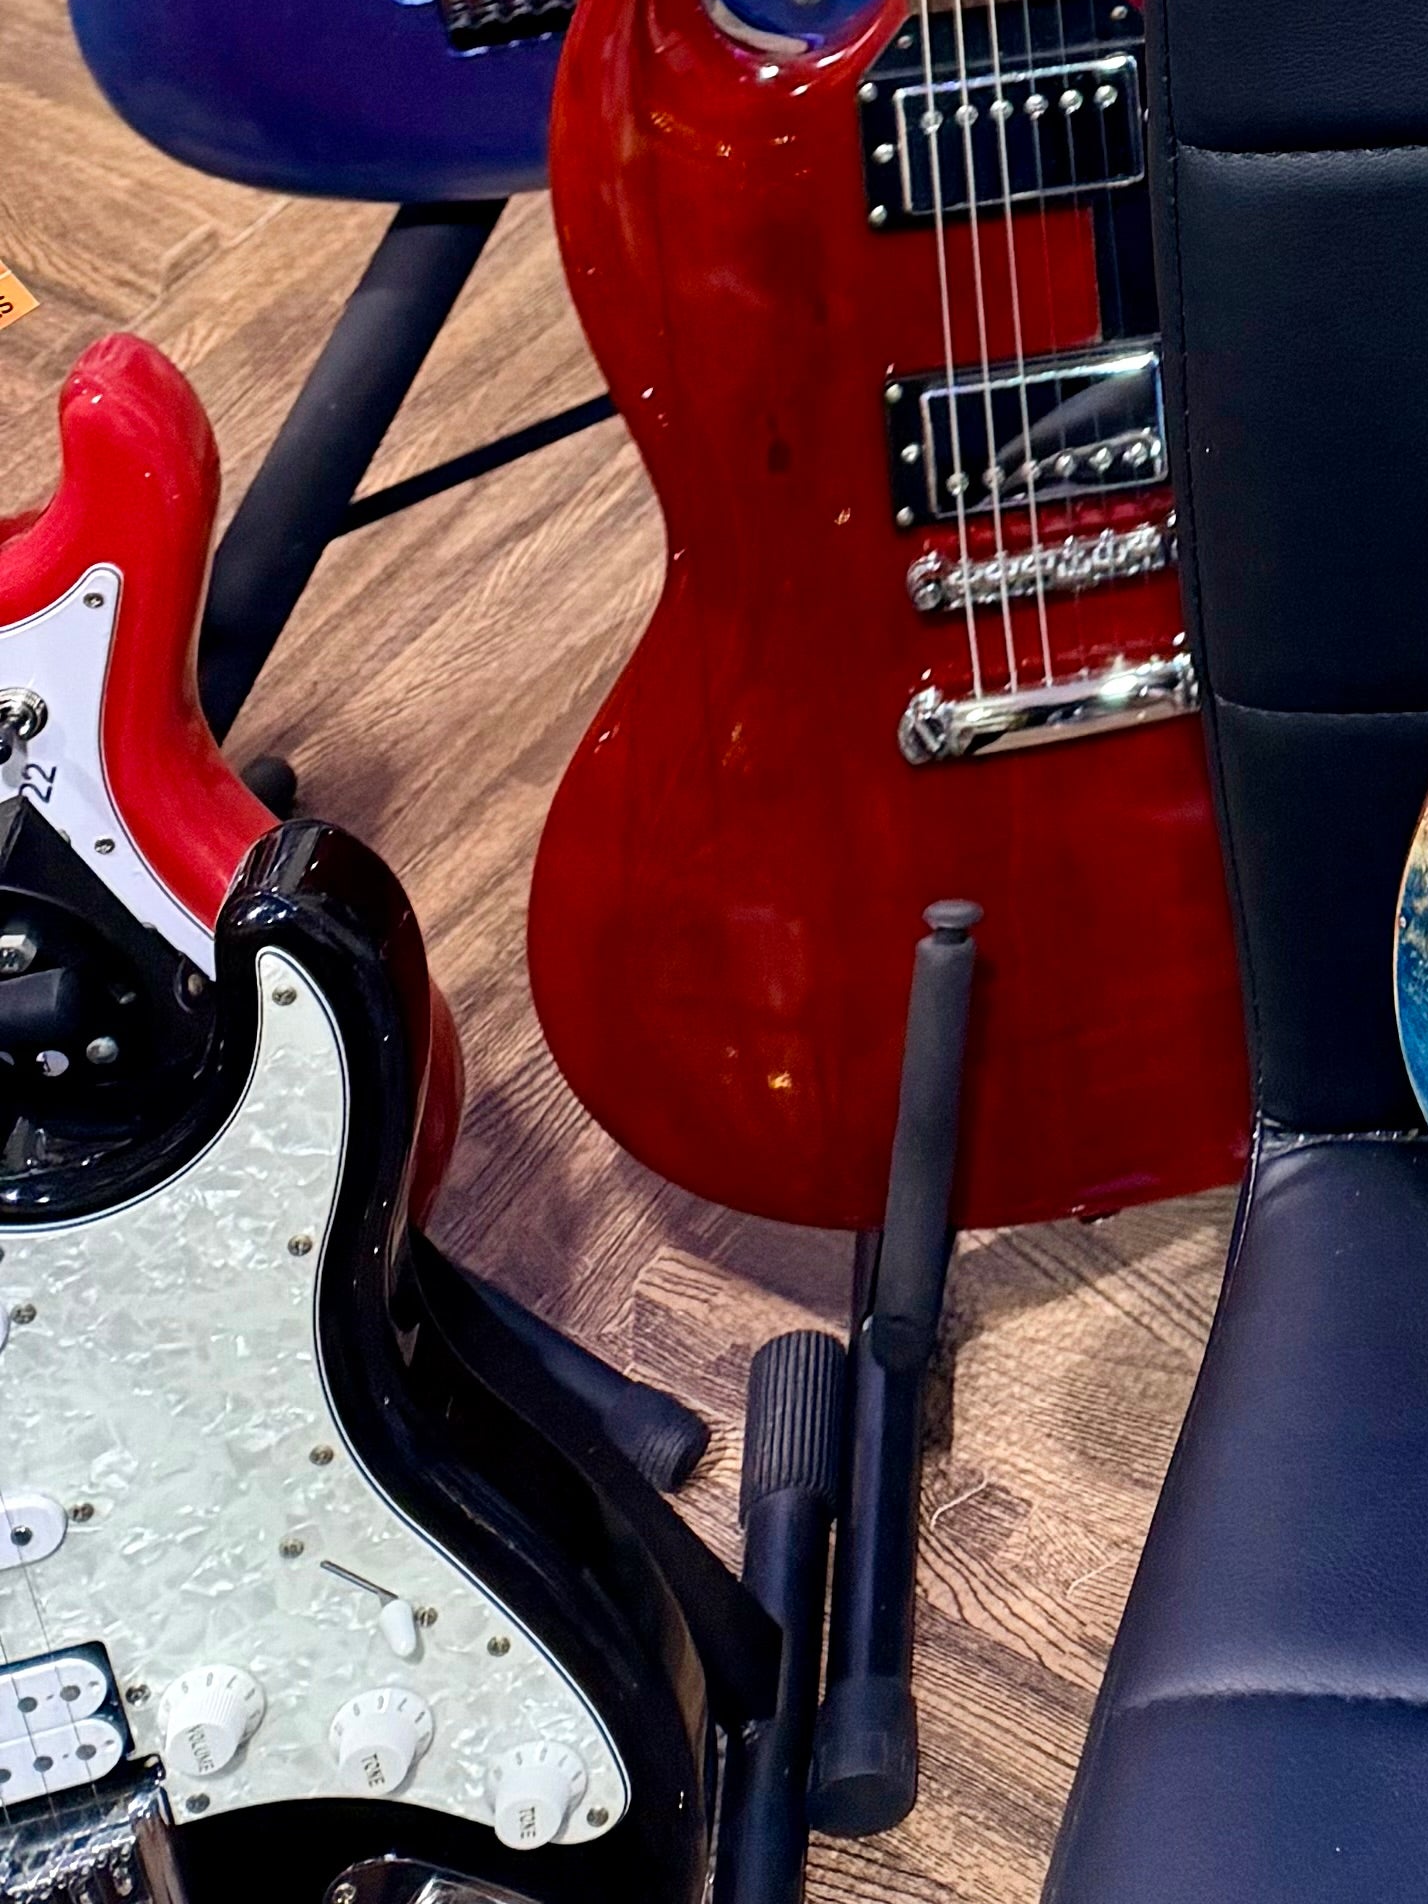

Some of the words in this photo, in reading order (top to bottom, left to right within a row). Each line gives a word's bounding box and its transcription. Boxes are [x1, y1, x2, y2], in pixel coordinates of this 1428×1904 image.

[186, 1724, 216, 1774] VOLUME
[361, 1752, 385, 1788] TONE
[518, 1806, 536, 1840] TONE
